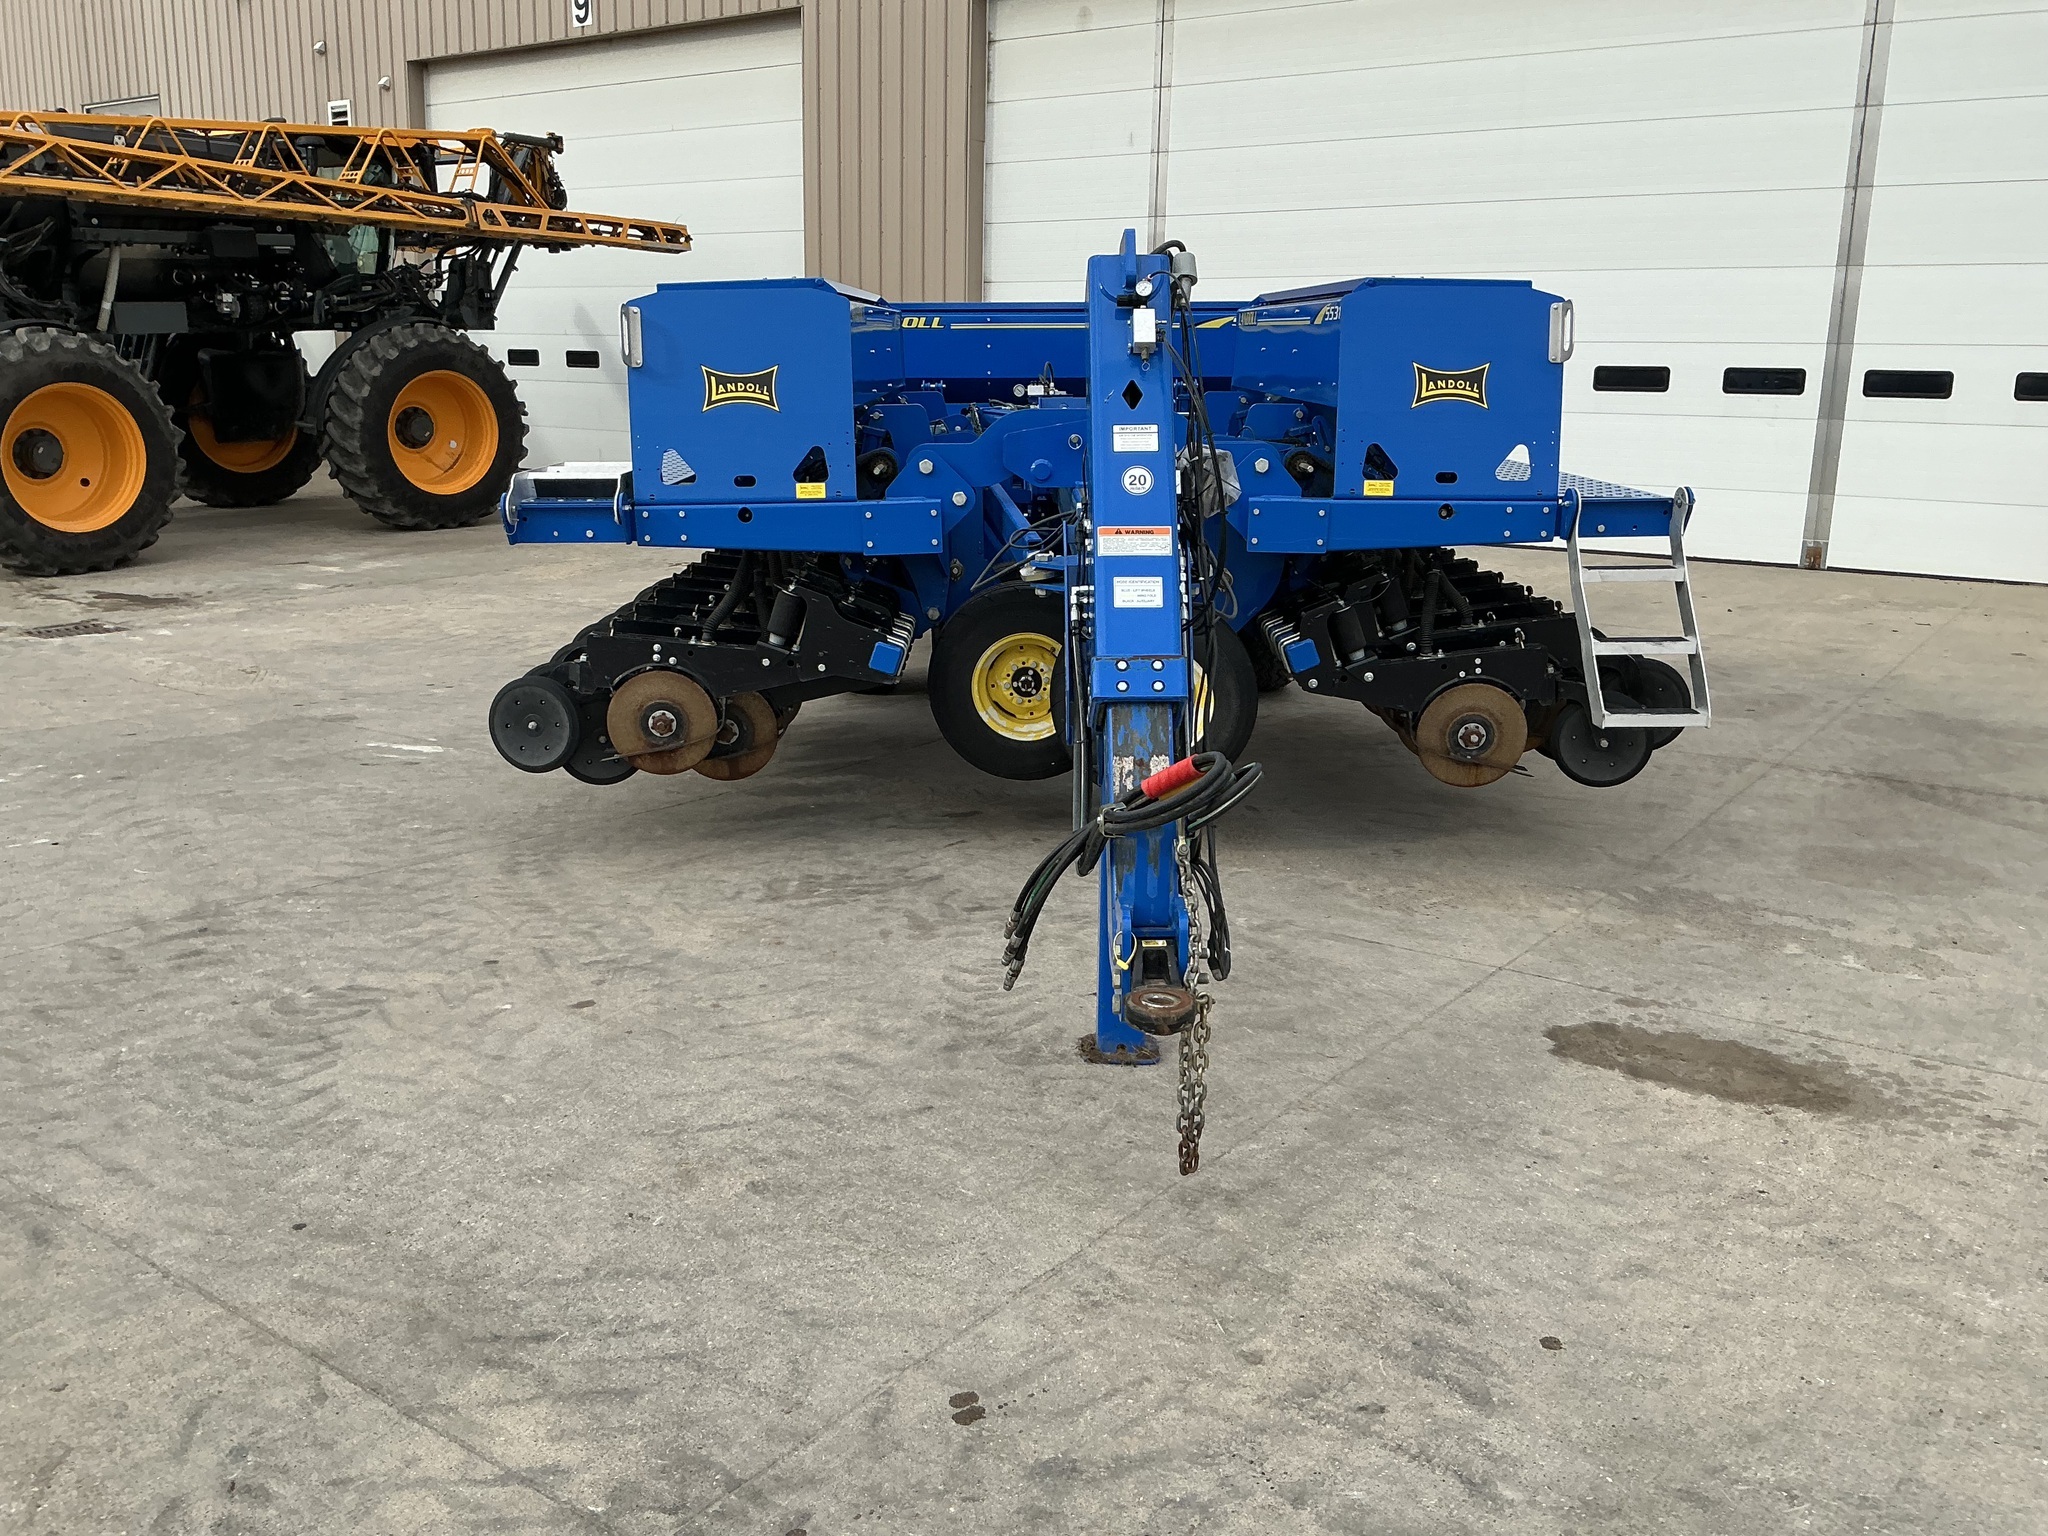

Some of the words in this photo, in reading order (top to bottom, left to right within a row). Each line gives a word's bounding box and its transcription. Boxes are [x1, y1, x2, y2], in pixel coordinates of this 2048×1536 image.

[574, 0, 589, 24] 9
[710, 375, 770, 401] LANDOLL
[1420, 372, 1480, 398] LANDOLL
[1128, 474, 1147, 486] 20
